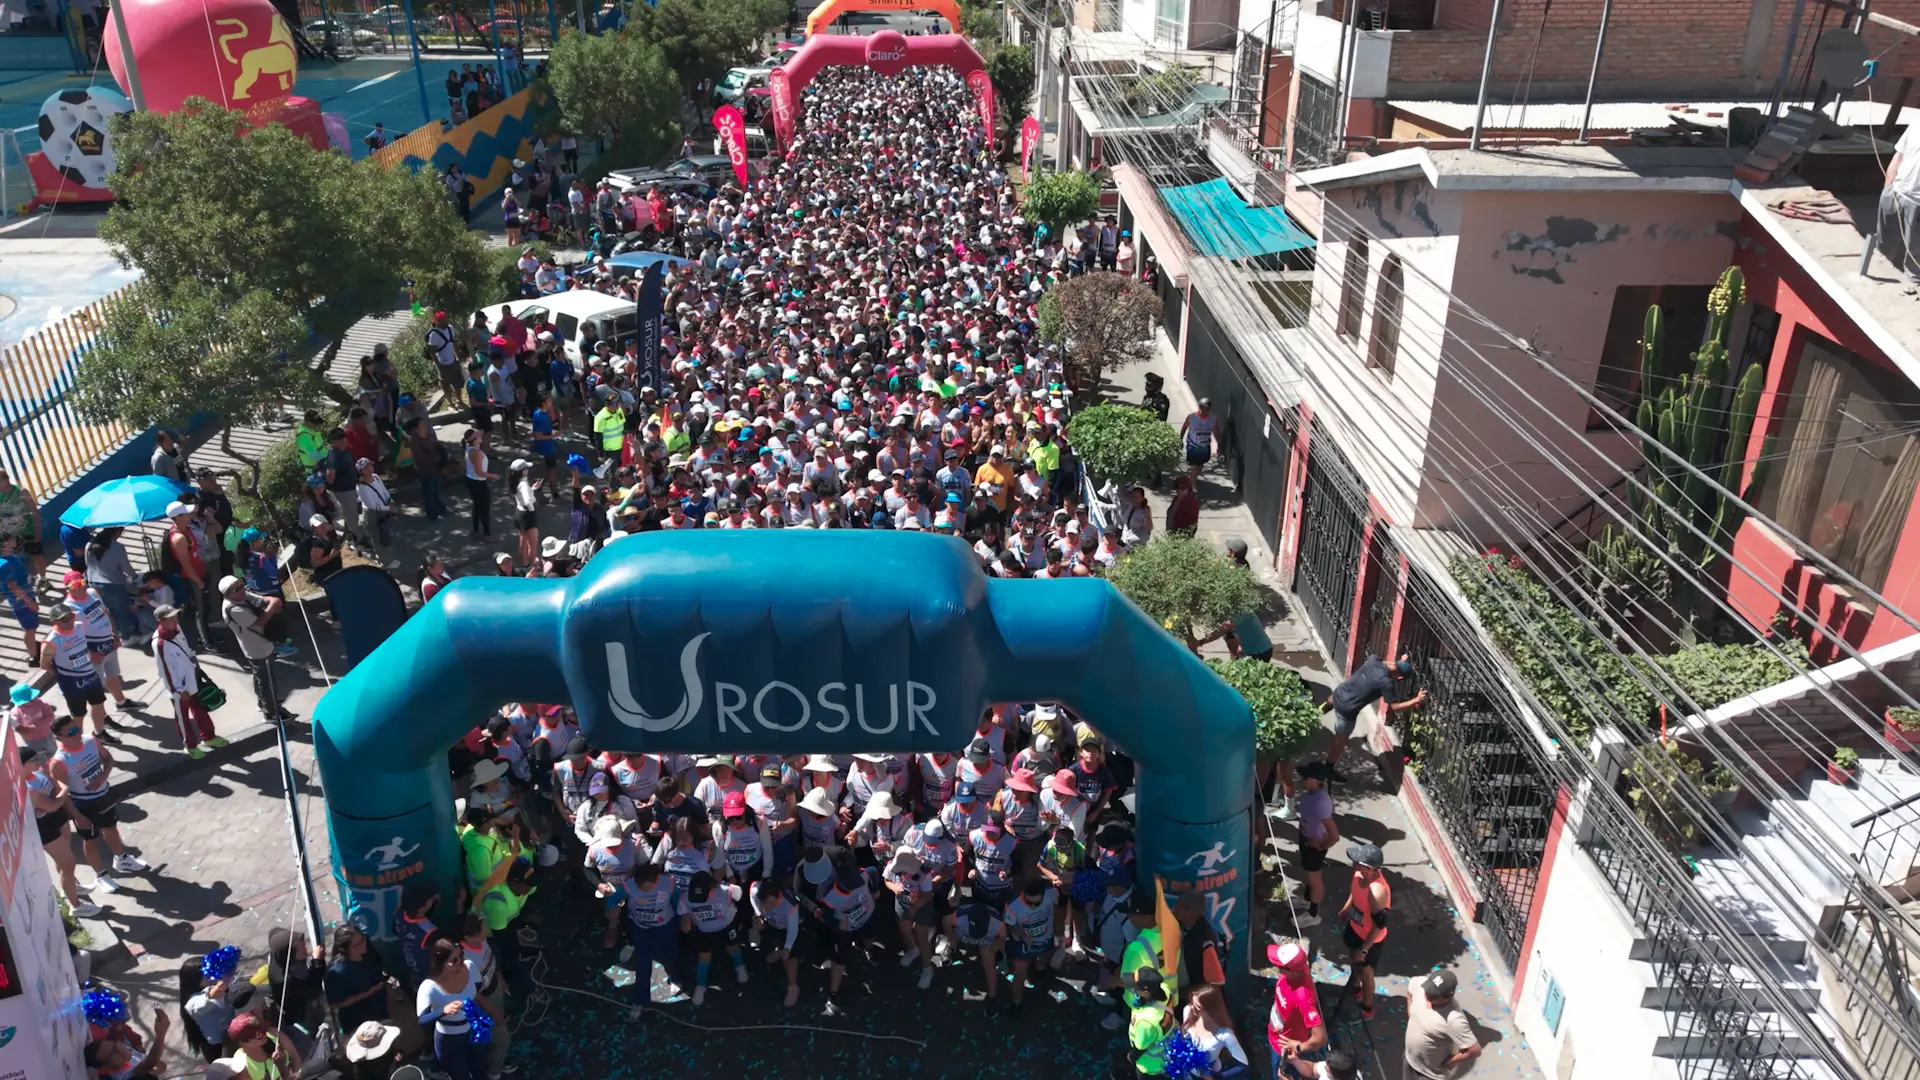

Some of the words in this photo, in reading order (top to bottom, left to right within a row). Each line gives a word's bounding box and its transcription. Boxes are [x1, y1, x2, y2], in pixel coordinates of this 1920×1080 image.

[868, 50, 900, 61] Claro
[720, 125, 744, 166] Claro
[1195, 867, 1238, 892] atrevo
